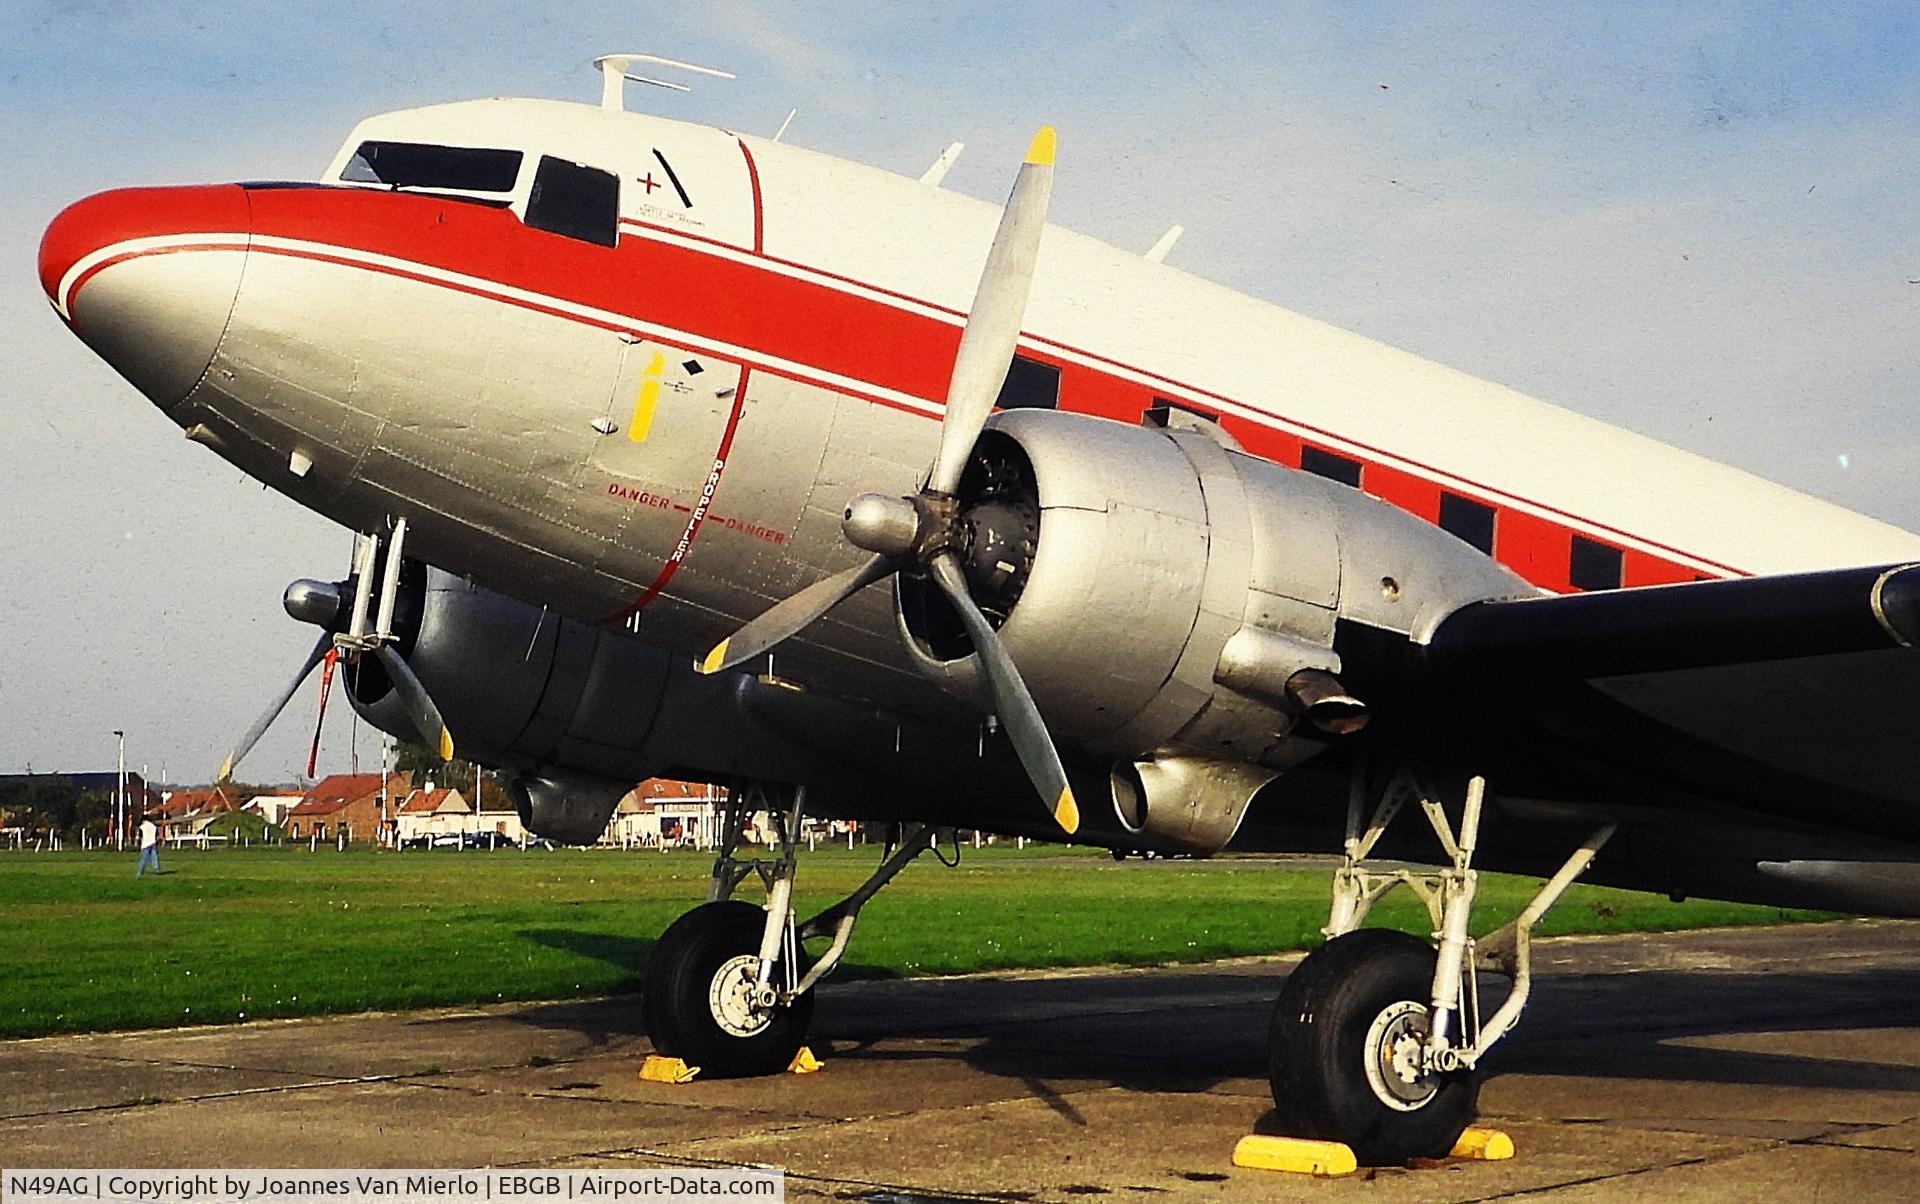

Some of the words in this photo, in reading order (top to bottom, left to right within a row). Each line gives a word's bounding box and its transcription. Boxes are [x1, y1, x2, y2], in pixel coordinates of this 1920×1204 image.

[608, 483, 670, 510] DANGER
[671, 459, 725, 563] PROPELLER
[725, 518, 786, 545] DANGER
